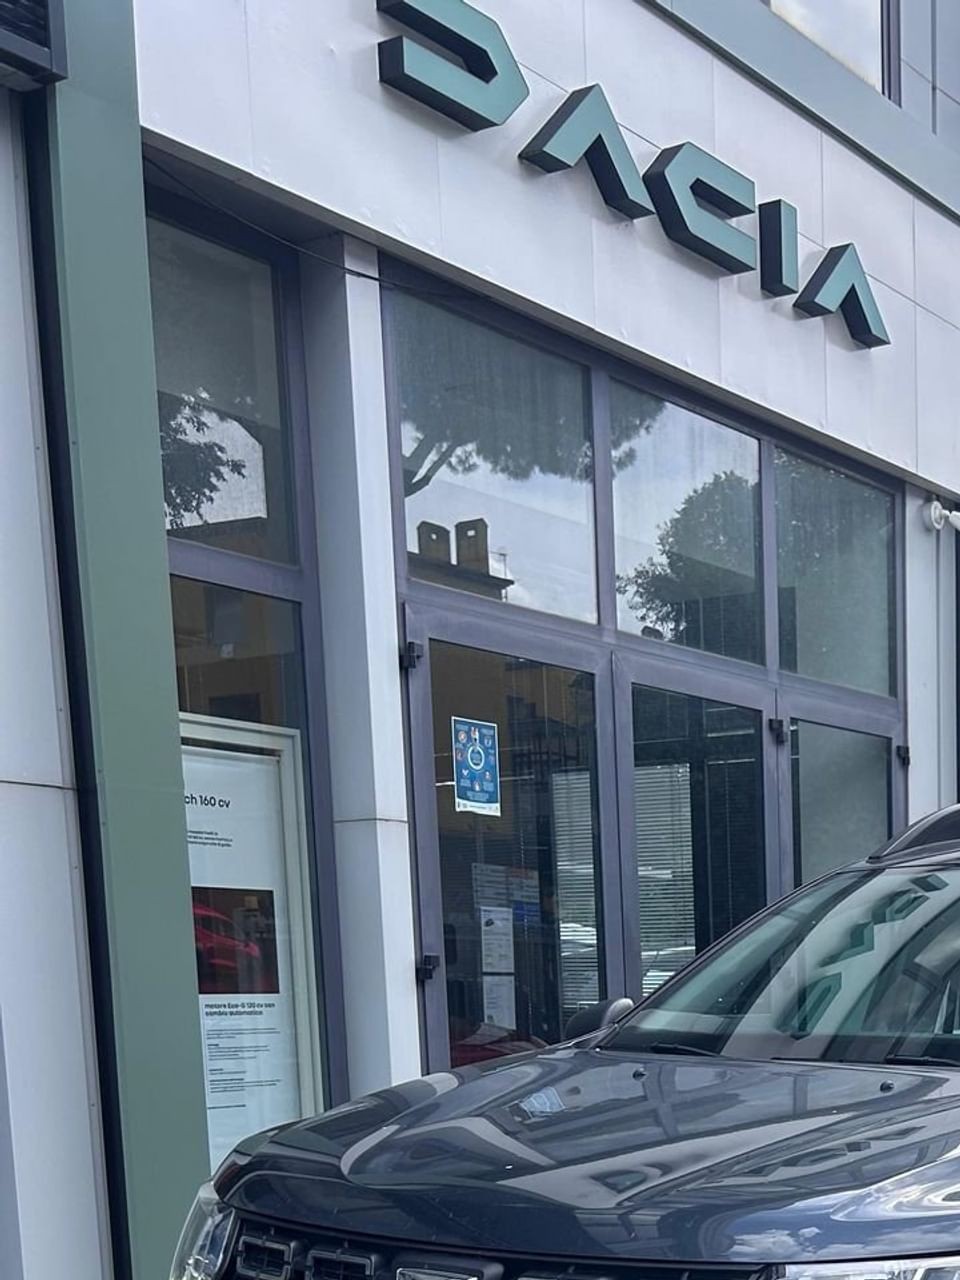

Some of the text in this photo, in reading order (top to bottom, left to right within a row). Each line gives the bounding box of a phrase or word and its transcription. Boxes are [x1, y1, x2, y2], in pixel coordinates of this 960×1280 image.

[378, 0, 891, 349] DACIA
[199, 795, 216, 807] 160
[218, 798, 231, 808] cv
